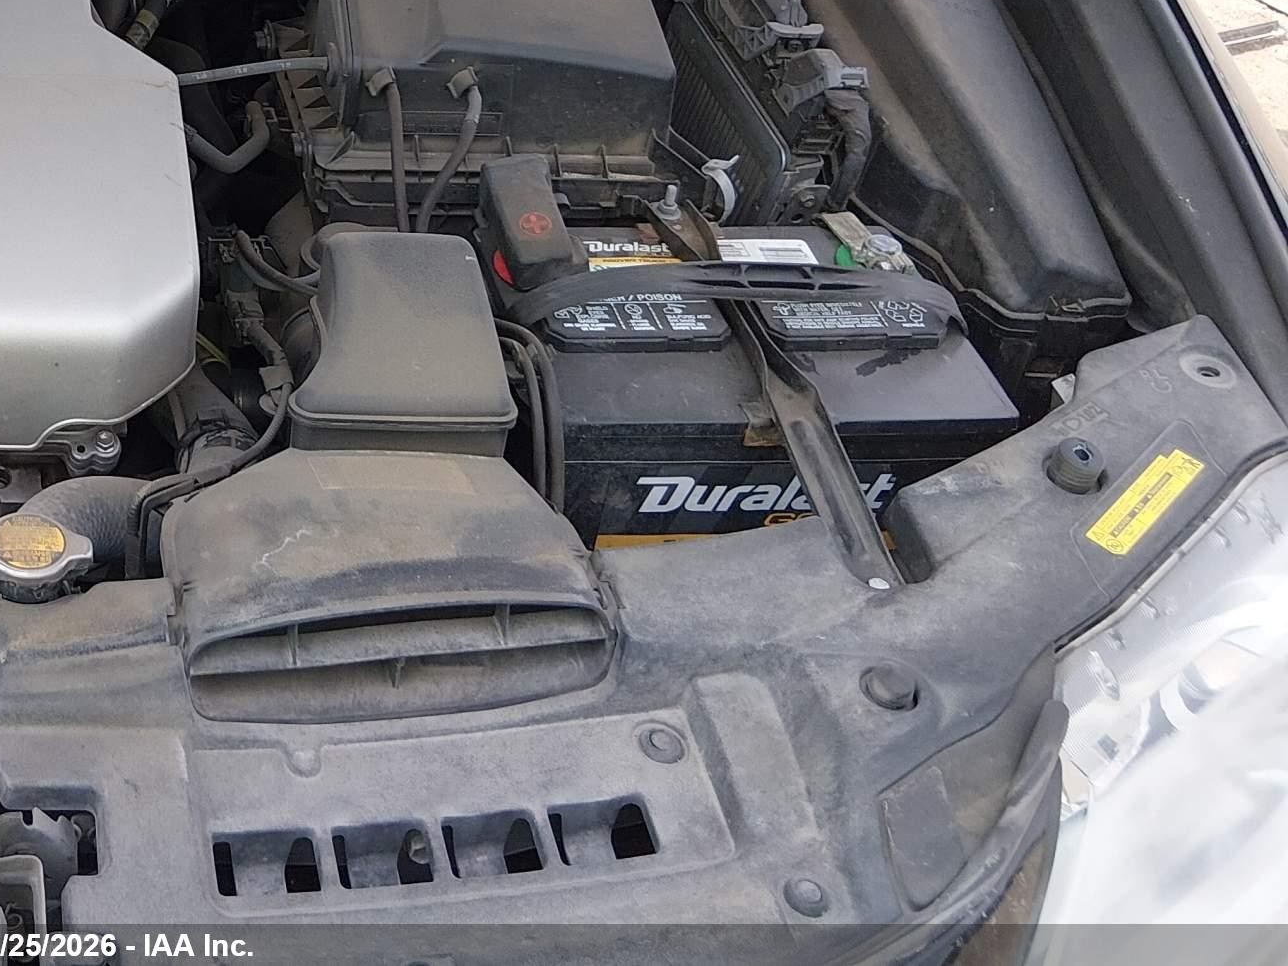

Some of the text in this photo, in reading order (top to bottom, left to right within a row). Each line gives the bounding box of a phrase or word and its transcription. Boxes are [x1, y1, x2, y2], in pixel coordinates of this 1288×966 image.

[583, 241, 671, 253] Duralast
[637, 293, 682, 301] POISON
[636, 474, 894, 512] Duralt
